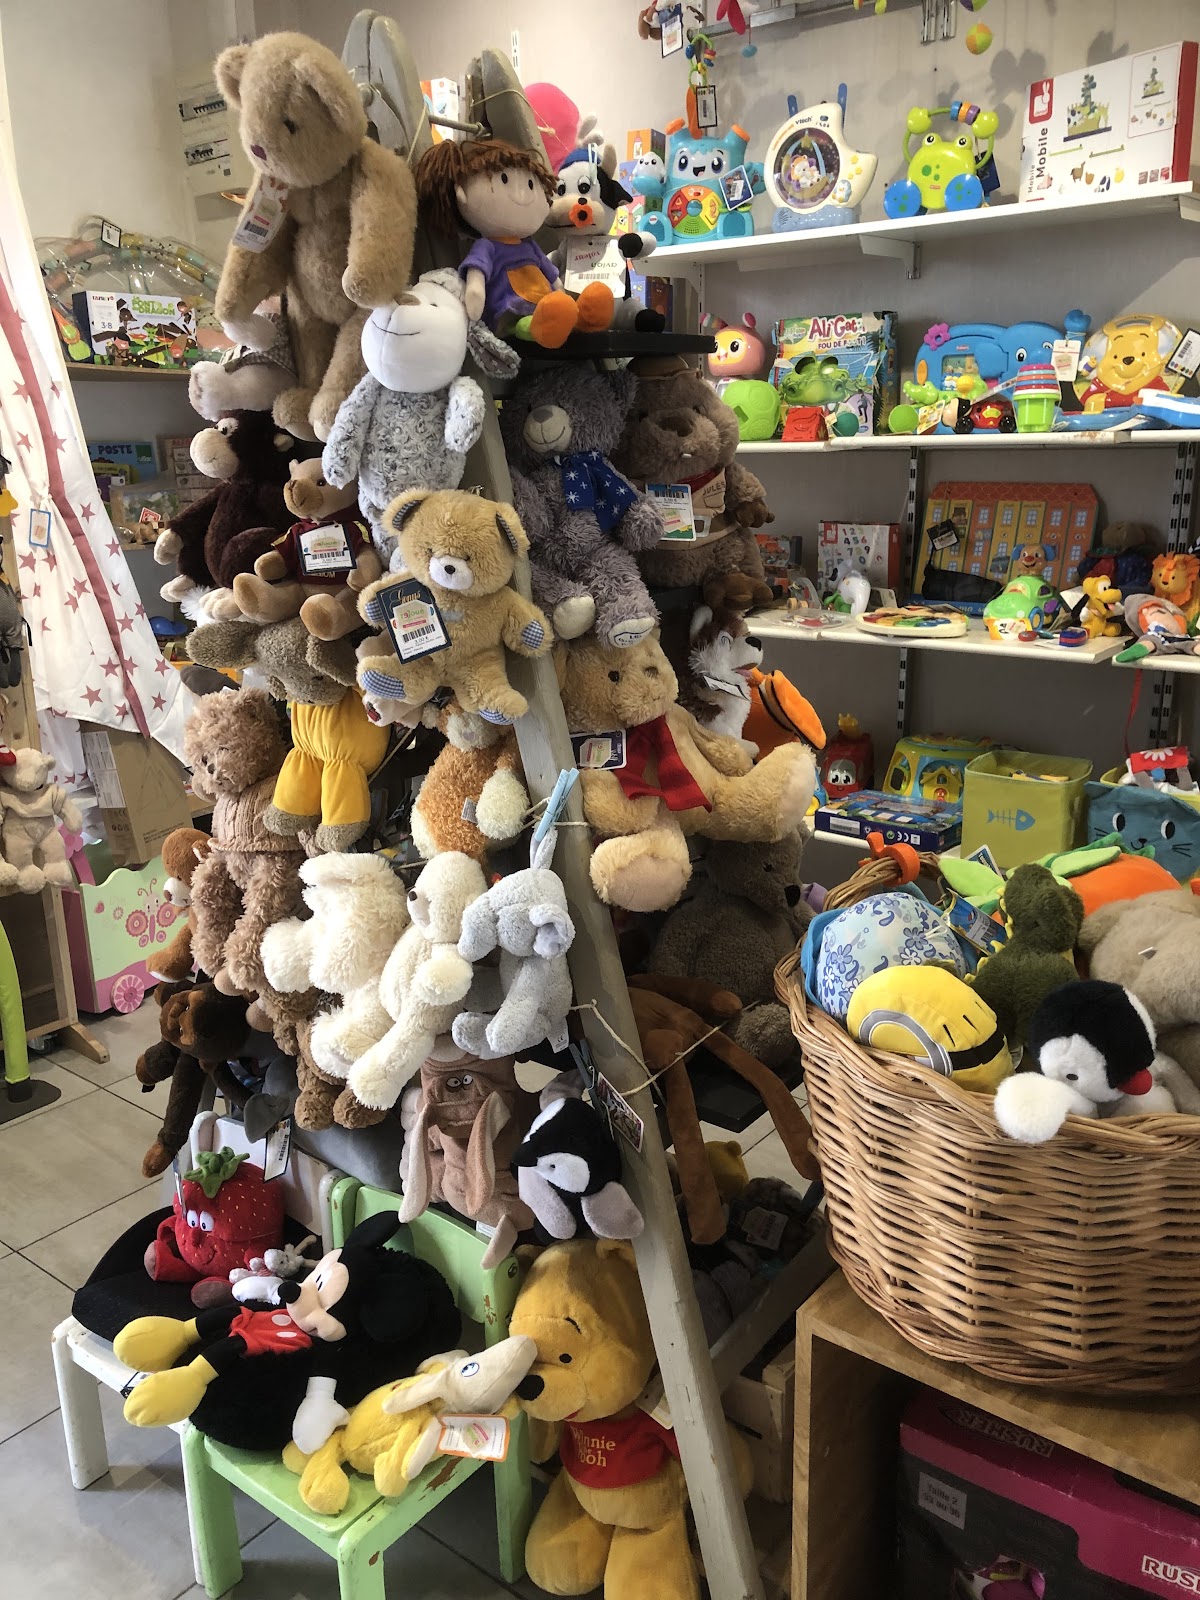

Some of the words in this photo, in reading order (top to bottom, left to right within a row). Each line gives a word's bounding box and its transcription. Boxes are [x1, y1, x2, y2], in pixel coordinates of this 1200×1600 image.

[795, 116, 813, 125] vtech
[1035, 127, 1048, 178] Mobile
[1027, 164, 1035, 193] Mobile
[132, 300, 155, 309] PONT
[138, 306, 176, 316] DRAGON
[818, 341, 832, 349] FOU
[98, 444, 133, 454] POSTE
[703, 481, 726, 496] JULES
[569, 1425, 616, 1451] Winnie
